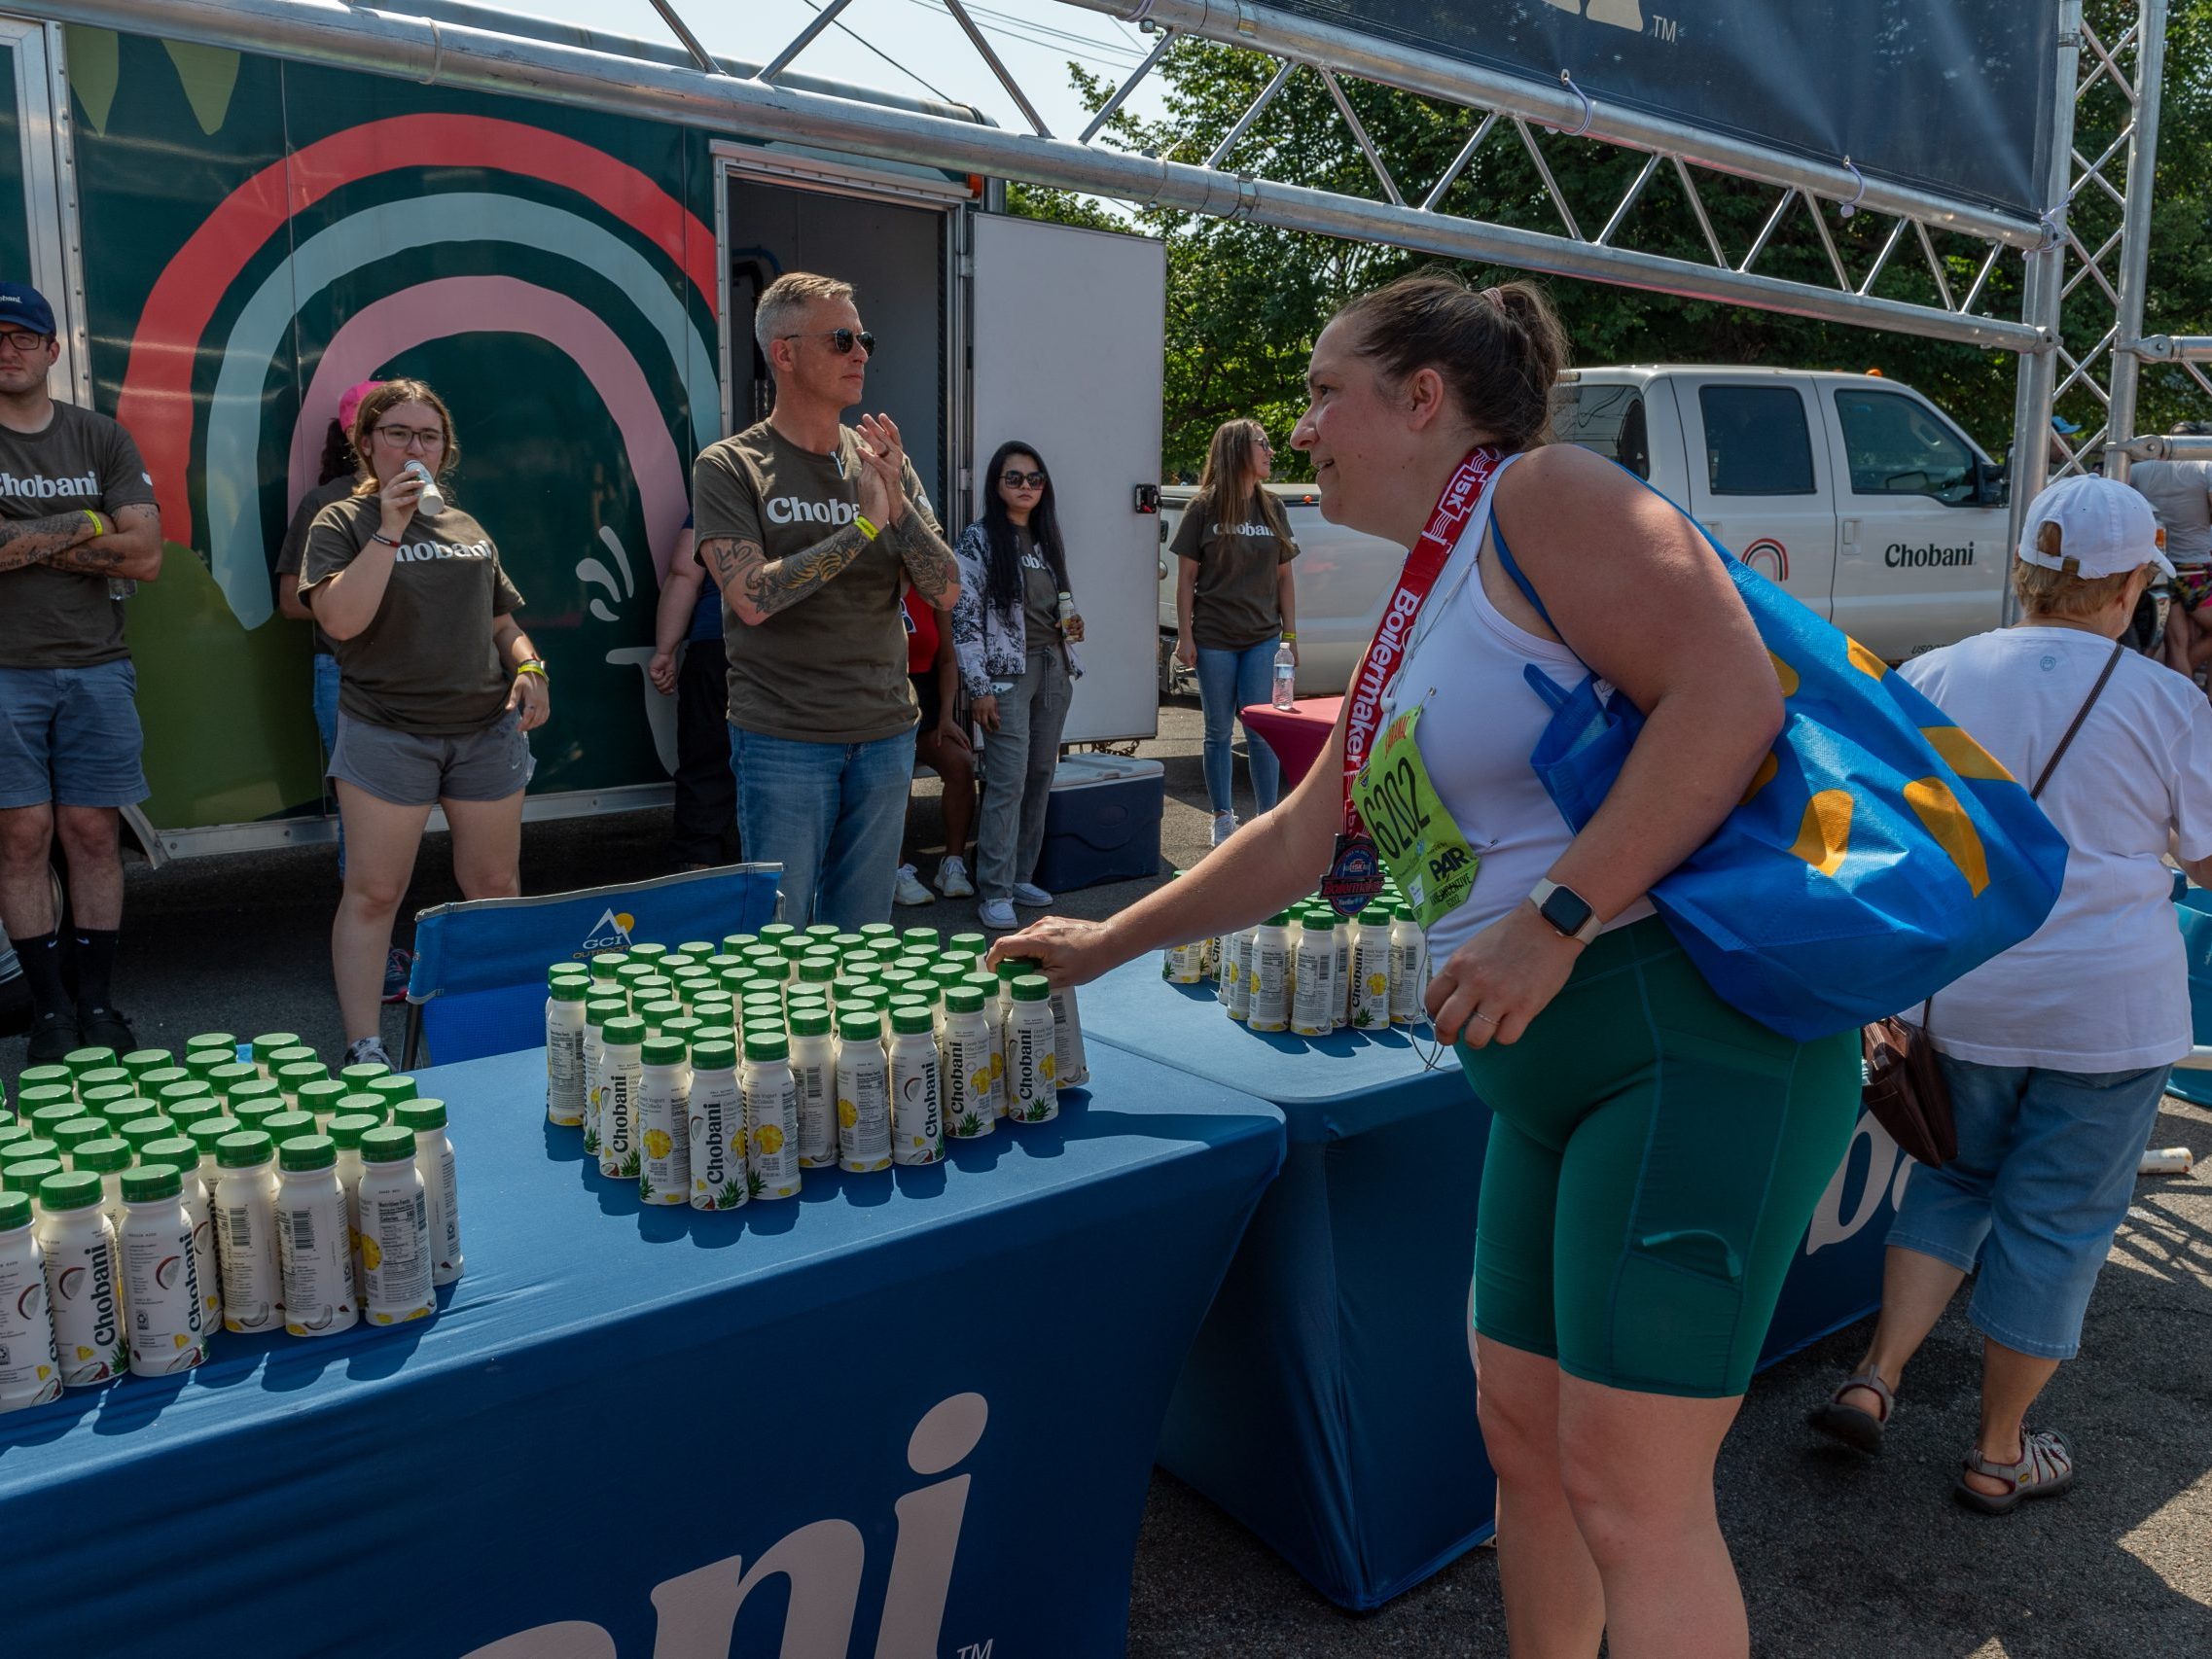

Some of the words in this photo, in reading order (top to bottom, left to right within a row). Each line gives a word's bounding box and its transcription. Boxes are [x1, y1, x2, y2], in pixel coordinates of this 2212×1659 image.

[1653, 15, 1677, 43] TM
[767, 497, 860, 525] Chob
[1445, 474, 1477, 510] 15K
[396, 540, 492, 562] hobani
[1884, 541, 1975, 568] Chobani
[1346, 586, 1423, 771] Boilermaker
[1363, 757, 1431, 860] 6202
[1428, 846, 1471, 883] PAR
[582, 935, 624, 950] GCI
[921, 1061, 938, 1138] Chobani
[948, 1041, 964, 1114] Chobani
[1017, 1029, 1033, 1100] Chobani
[610, 1074, 628, 1153] Chobani
[702, 1103, 725, 1184] Chobani
[84, 1241, 117, 1347] Chobani
[179, 1231, 202, 1332] Chobani
